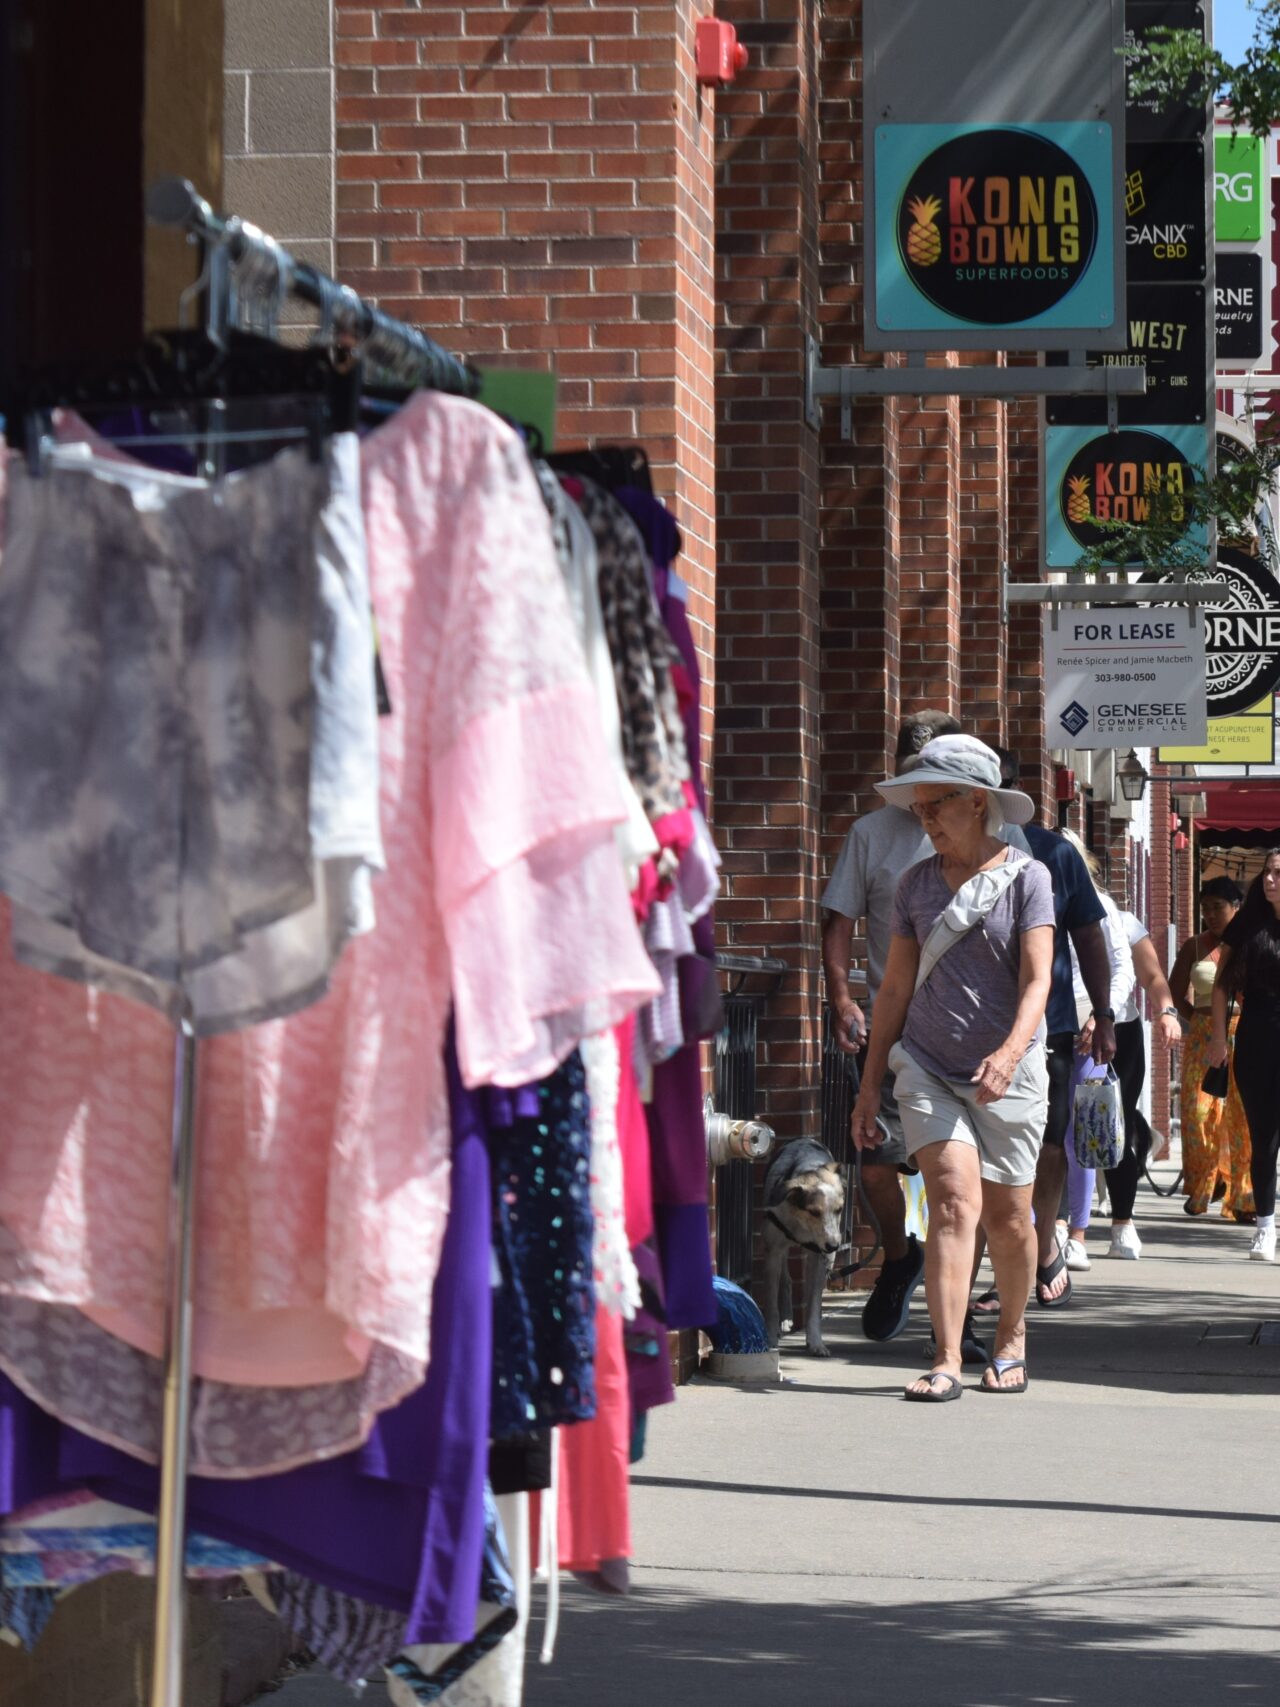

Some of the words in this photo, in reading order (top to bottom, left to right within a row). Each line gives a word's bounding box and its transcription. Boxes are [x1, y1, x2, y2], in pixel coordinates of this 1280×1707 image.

[948, 175, 1079, 225] KONA
[949, 224, 1080, 265] BOWLS
[1153, 245, 1187, 259] CBD
[955, 267, 1069, 280] SUPERFOODS
[1129, 321, 1187, 350] WEST
[1102, 355, 1147, 368] TRADERS
[1170, 376, 1188, 386] GUNS
[1095, 462, 1184, 496] KONA
[1074, 624, 1112, 641] FOR
[1119, 623, 1175, 640] LEASE
[1057, 657, 1083, 666] Renée
[1085, 656, 1111, 667] Spicer
[1113, 656, 1128, 665] and
[1130, 655, 1155, 666] Jamie
[1156, 655, 1193, 664] Macbeth
[1094, 673, 1156, 682] 303-980-0500
[1097, 703, 1187, 717] GENESEE
[1097, 717, 1187, 727] COMMERCIAL
[1215, 725, 1265, 733] ACUPUNCTURE
[1227, 735, 1250, 743] HERBS
